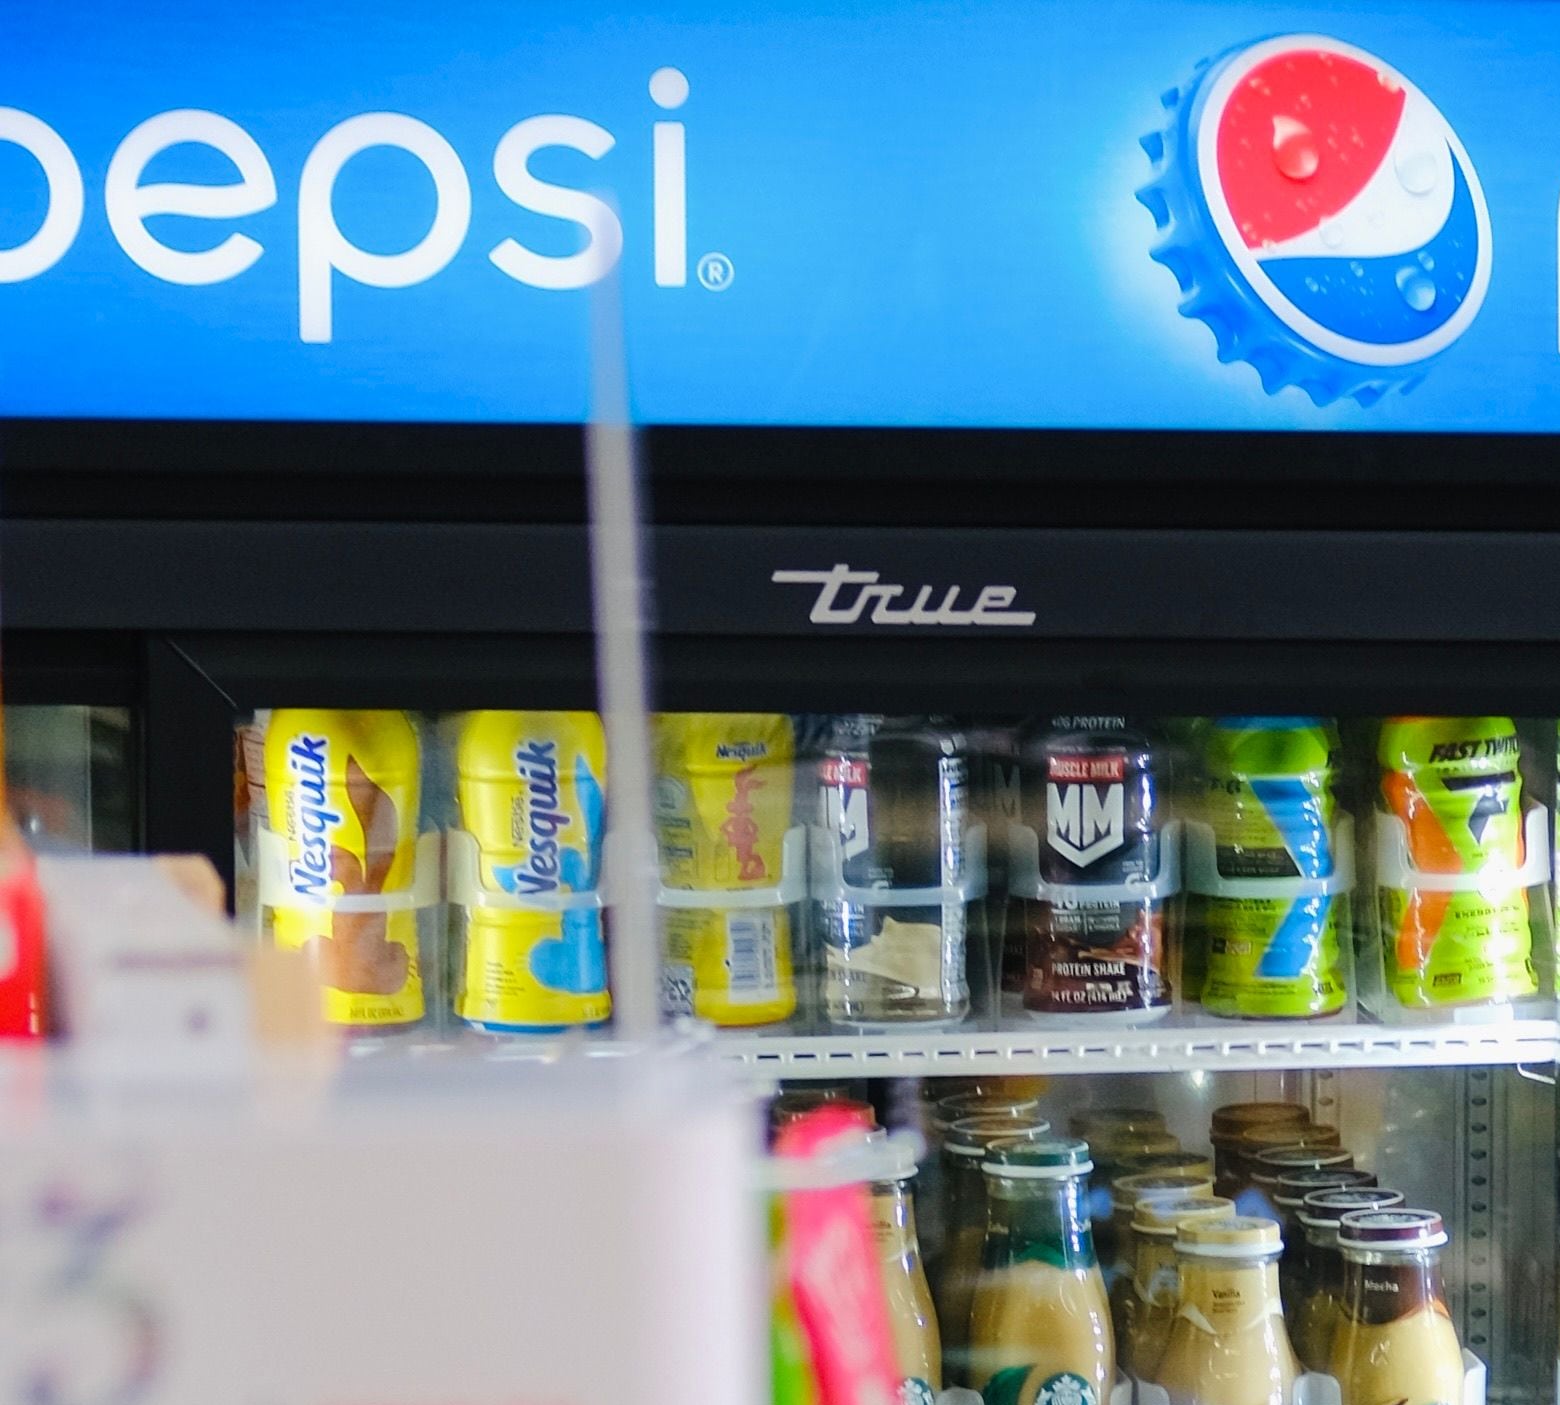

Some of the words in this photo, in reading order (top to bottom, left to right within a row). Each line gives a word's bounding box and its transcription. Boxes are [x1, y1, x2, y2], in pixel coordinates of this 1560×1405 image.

[770, 562, 1036, 627] true
[1090, 757, 1120, 777] MILK
[289, 736, 340, 899] Nesquik
[516, 741, 570, 897] Nesquik
[1052, 961, 1092, 977] PROTEIN
[1093, 960, 1126, 976] SHAKE
